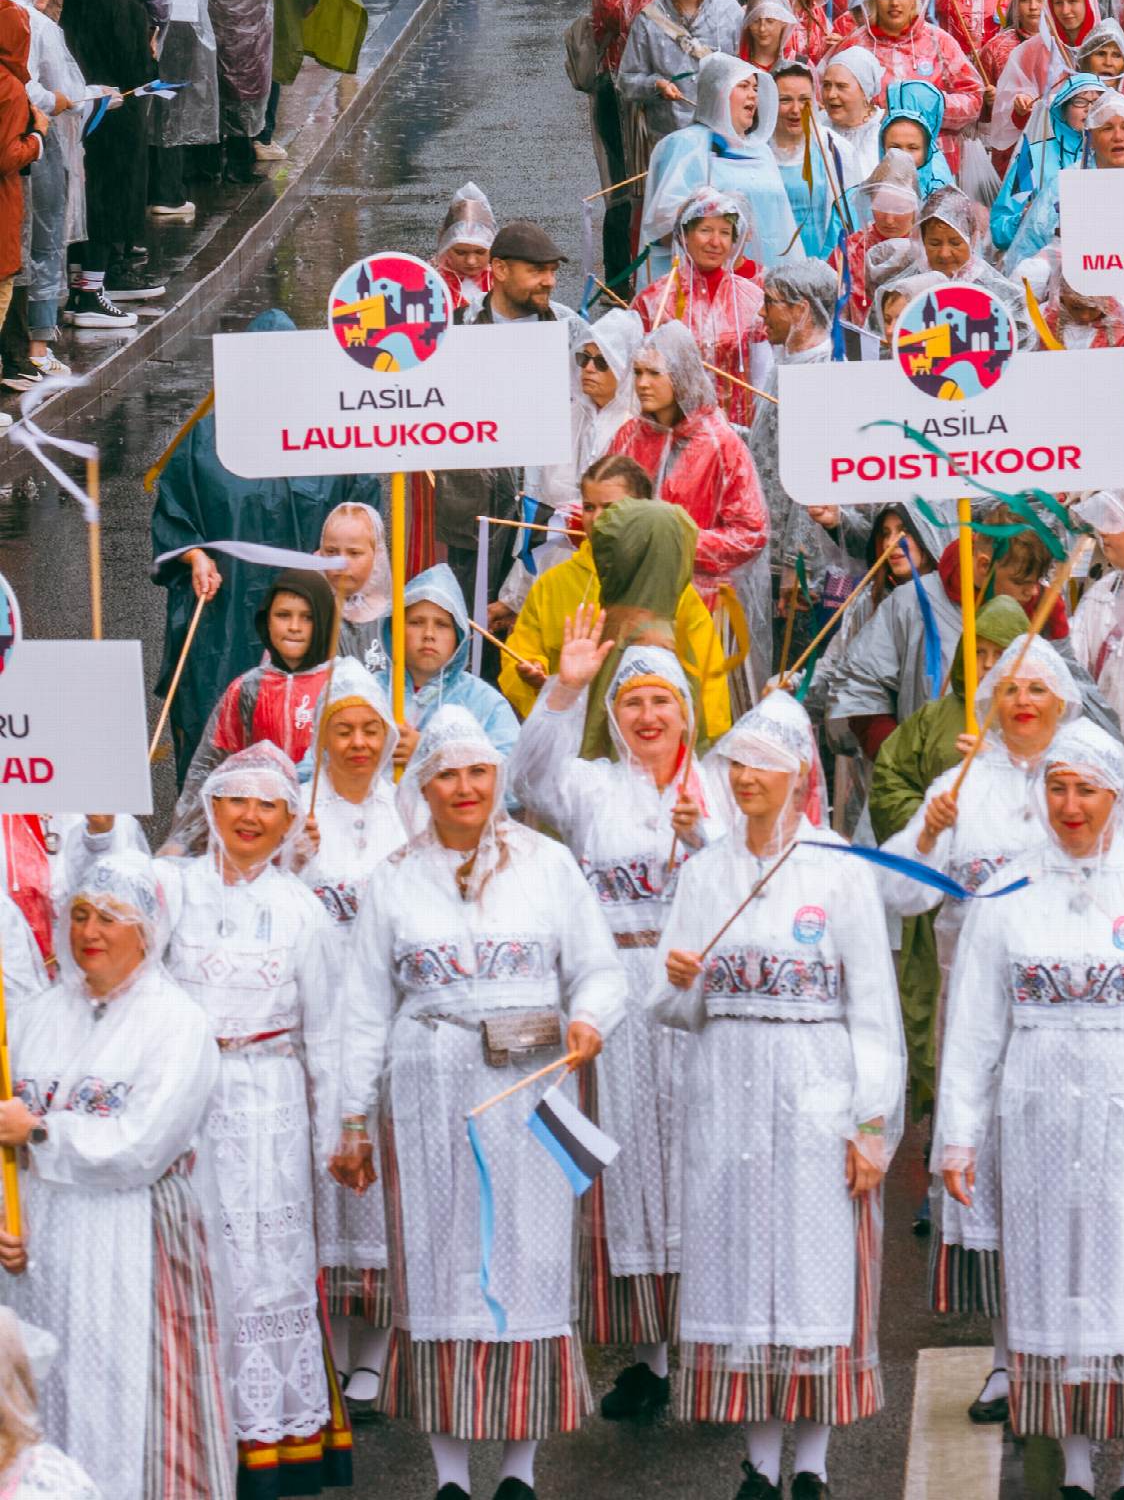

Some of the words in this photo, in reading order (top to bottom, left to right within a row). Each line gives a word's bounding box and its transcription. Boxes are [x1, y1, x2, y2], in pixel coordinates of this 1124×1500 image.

[339, 388, 446, 411] LASILA
[281, 420, 499, 452] LAULUKOOR
[903, 414, 1009, 440] LASILA
[831, 445, 1082, 483] POISTEKOOR
[0, 714, 30, 738] RU
[0, 757, 55, 784] AD
